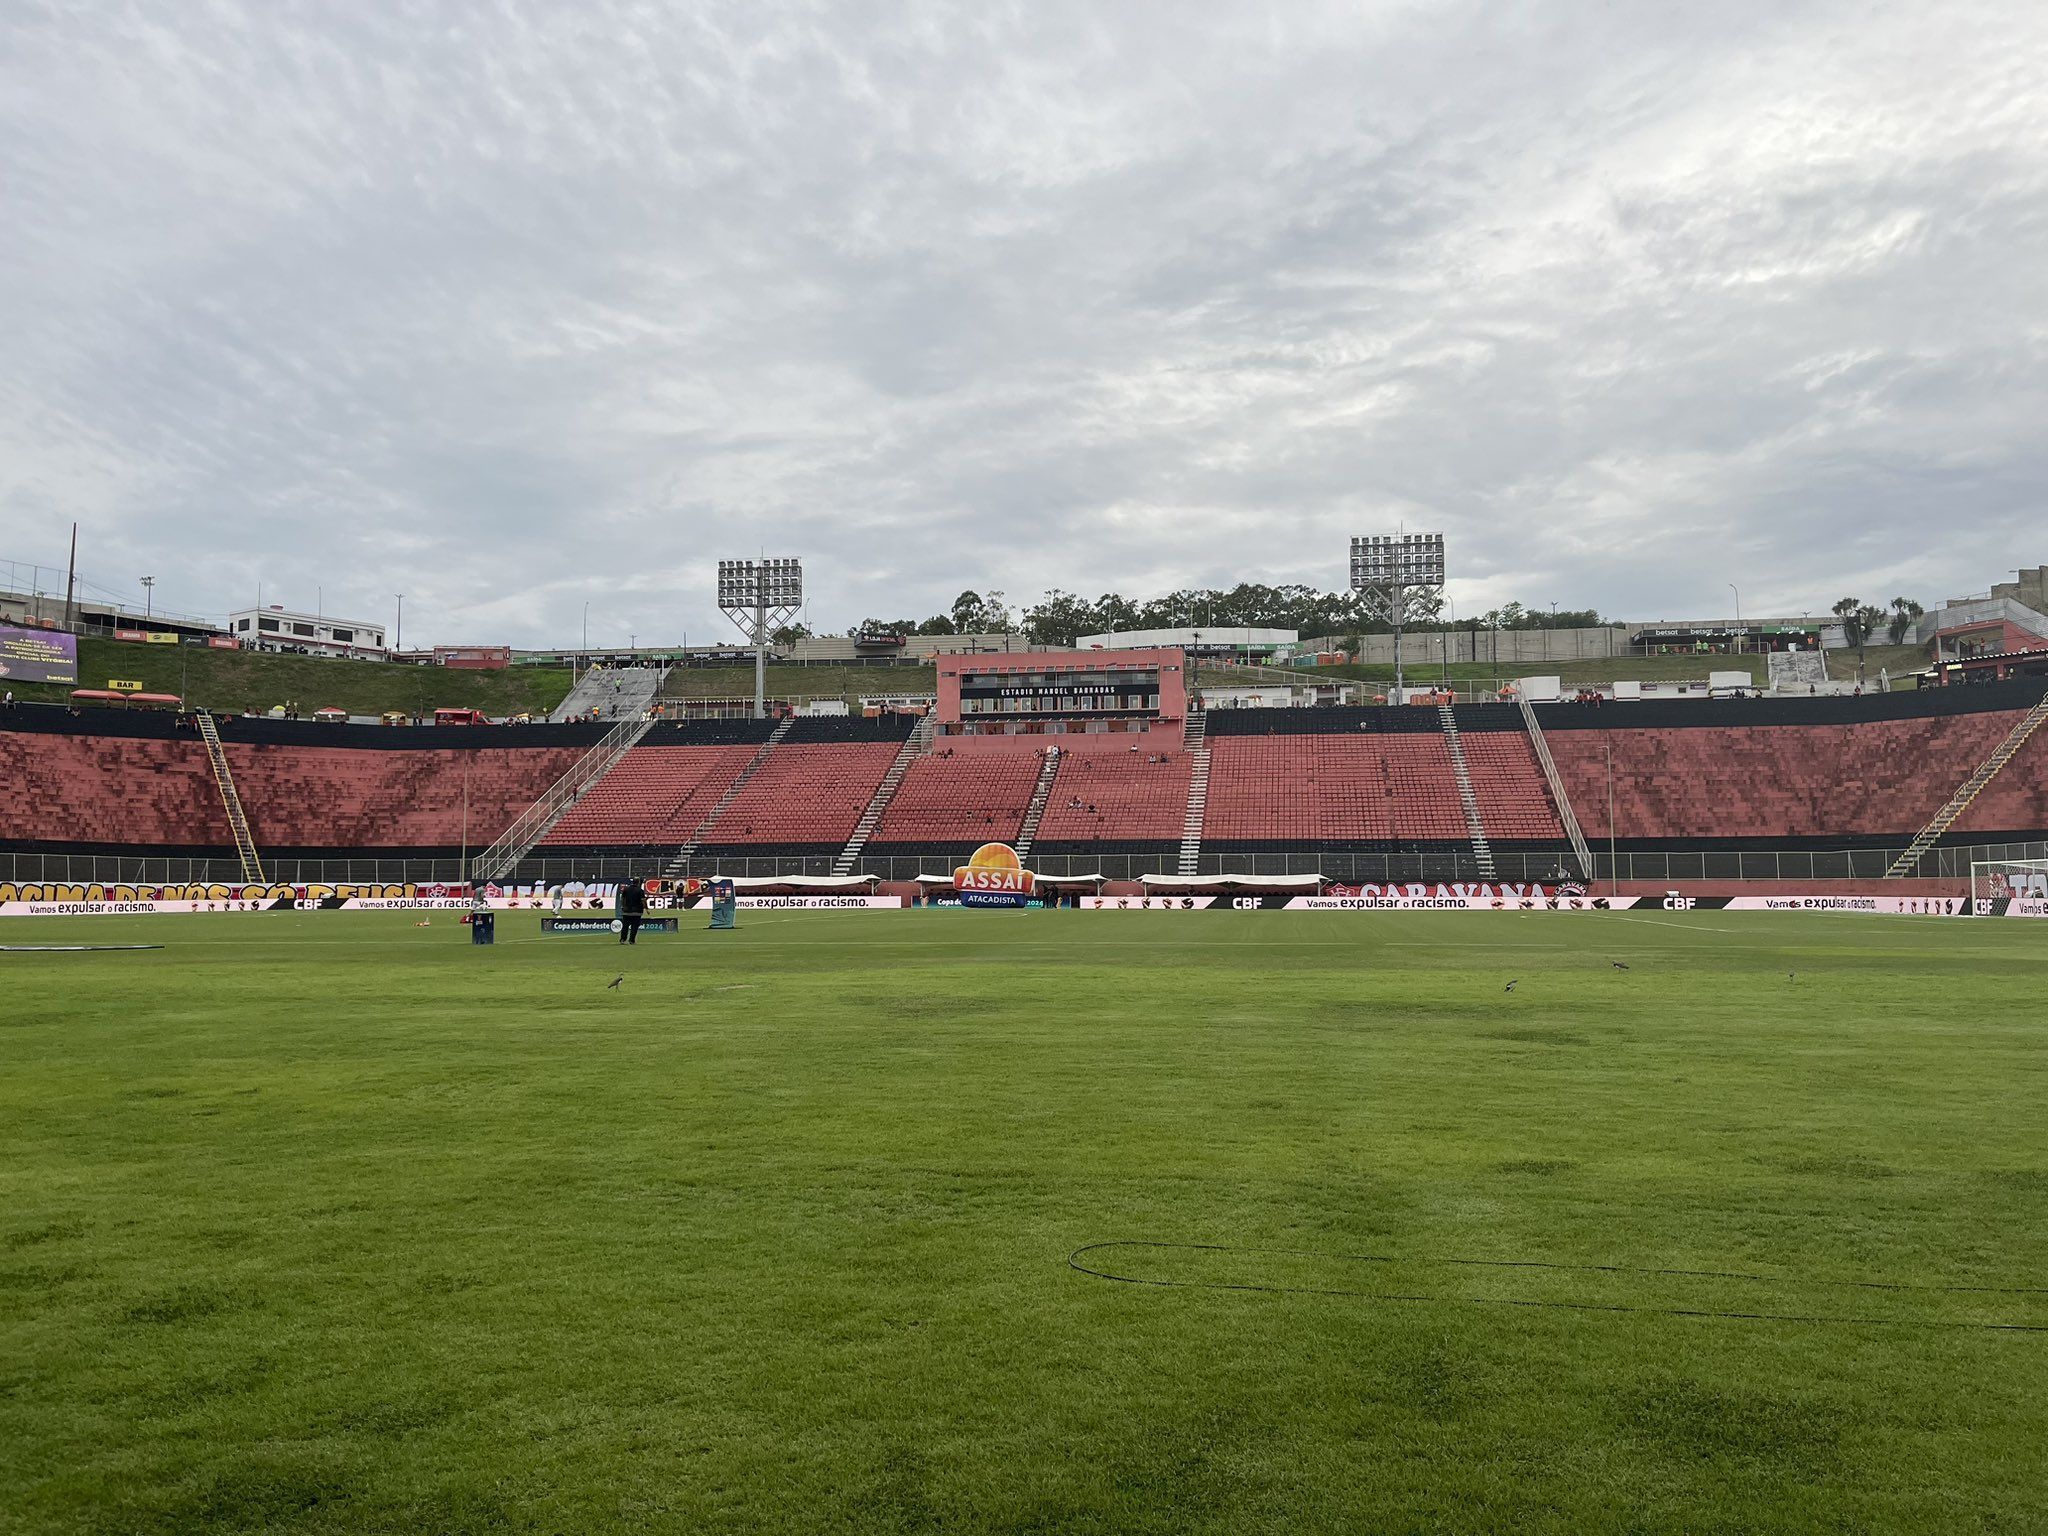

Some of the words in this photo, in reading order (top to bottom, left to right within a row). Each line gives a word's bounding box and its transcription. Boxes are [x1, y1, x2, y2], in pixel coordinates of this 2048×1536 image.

[1074, 686, 1115, 694] BARRADAS
[961, 870, 1024, 890] ASSAÍ
[293, 898, 323, 910] CBF
[359, 901, 385, 909] Vamos
[387, 897, 434, 911] expulsar
[646, 898, 673, 909] CBF
[757, 896, 808, 909] expulsar
[819, 896, 869, 907] racismo.
[937, 898, 955, 907] Copa
[968, 895, 1016, 905] ATACADISTA
[1232, 897, 1262, 909] CBF
[1307, 900, 1338, 908] Vamos
[1340, 896, 1399, 910] expulsar
[1411, 897, 1469, 908] racismo.
[1663, 897, 1696, 910] CBF
[1766, 899, 1801, 908] Vamos
[29, 905, 56, 914] Vamos
[58, 901, 104, 915] expulsar
[114, 901, 156, 912] racismo.
[1975, 898, 1993, 915] CBF
[553, 922, 570, 931] Copa
[571, 922, 579, 930] do
[580, 922, 610, 930] Nordeste
